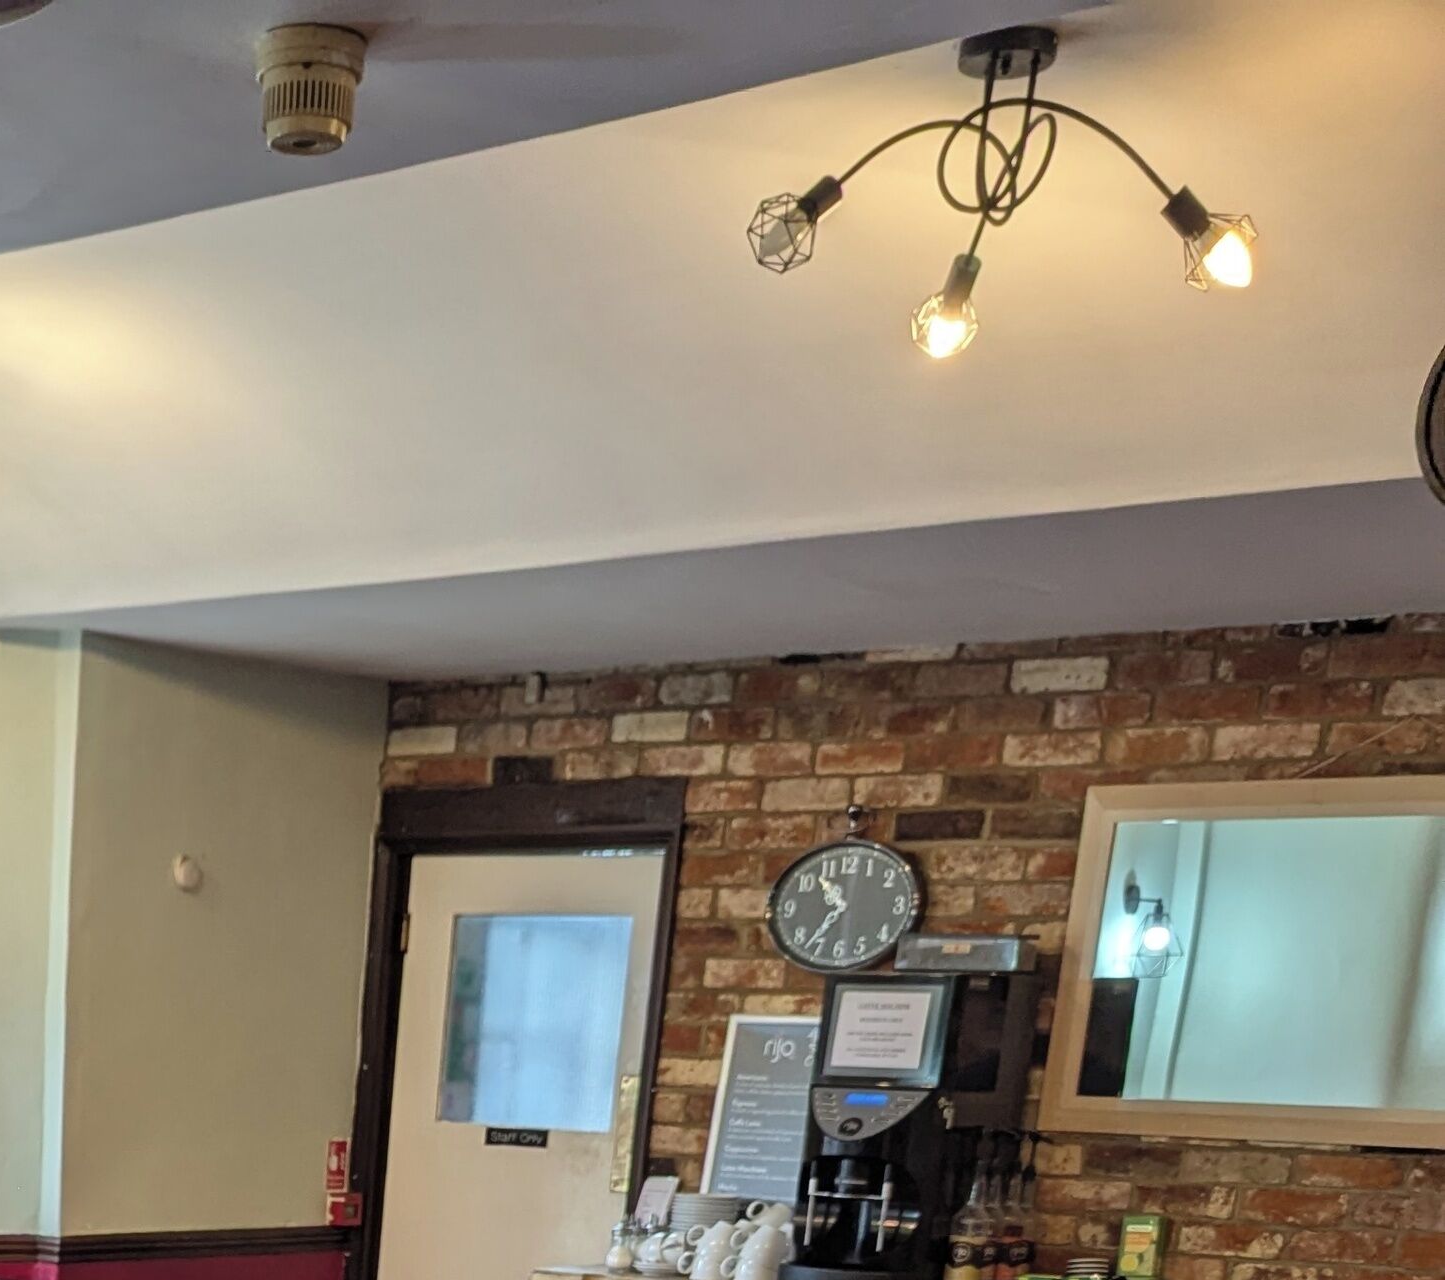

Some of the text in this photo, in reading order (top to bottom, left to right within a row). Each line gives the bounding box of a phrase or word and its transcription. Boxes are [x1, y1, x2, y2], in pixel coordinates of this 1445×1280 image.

[821, 860, 836, 878] 11
[841, 856, 858, 874] 12
[866, 858, 874, 877] 1
[798, 873, 814, 892] 10
[883, 868, 895, 888] 2
[784, 900, 796, 918] 9
[893, 895, 906, 915] 3
[794, 926, 806, 945] 8
[877, 923, 889, 942] 4
[814, 937, 826, 956] 7
[833, 940, 845, 958] 6
[854, 936, 866, 955] 5
[763, 1038, 794, 1063] rijo
